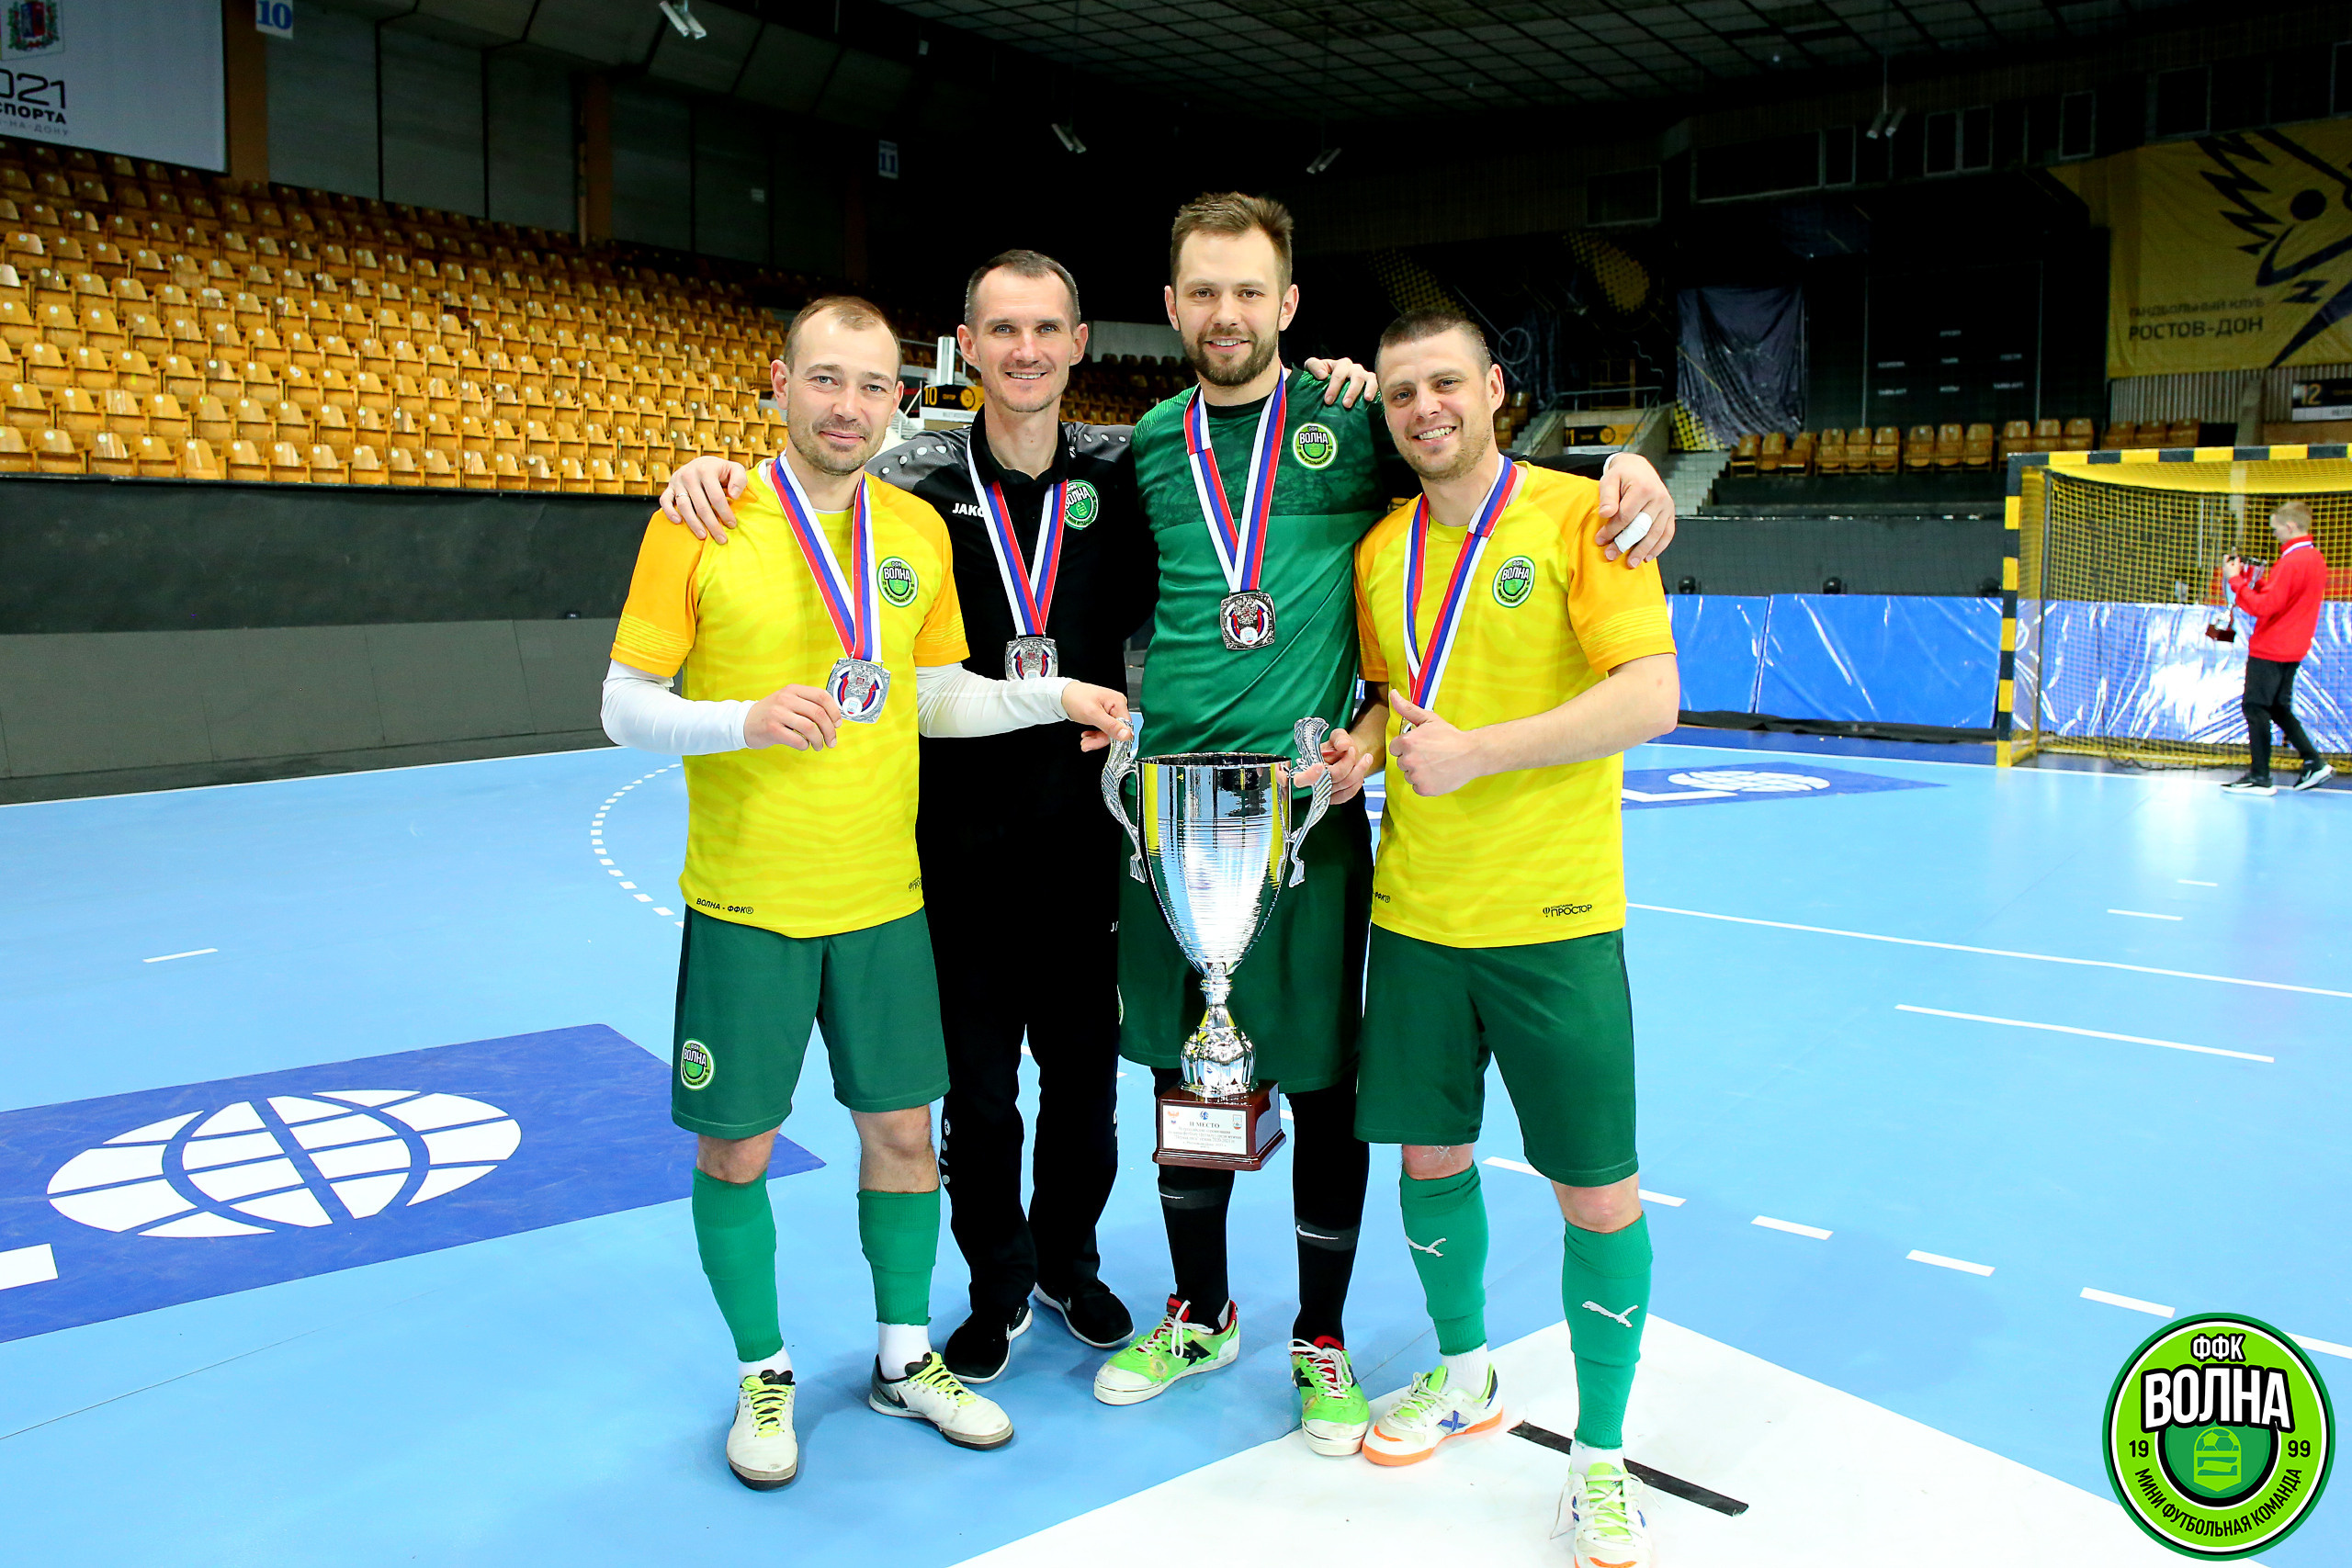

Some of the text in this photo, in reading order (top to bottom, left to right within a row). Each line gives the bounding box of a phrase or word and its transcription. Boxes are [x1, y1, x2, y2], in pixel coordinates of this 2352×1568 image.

[256, 1, 293, 29] 10
[0, 102, 66, 124] ПОРТА
[2129, 316, 2264, 341] РОСТОВ-ДОН
[923, 387, 938, 406] 10
[2301, 383, 2322, 405] 12
[1299, 432, 1329, 445] ВОЛНА
[883, 567, 911, 582] ВОЛНА
[1501, 567, 1530, 581] ВОЛНА
[695, 897, 720, 910] ВОЛНА
[1551, 904, 1592, 917] ПРОСТОР
[684, 1048, 707, 1067] ВОЛНА
